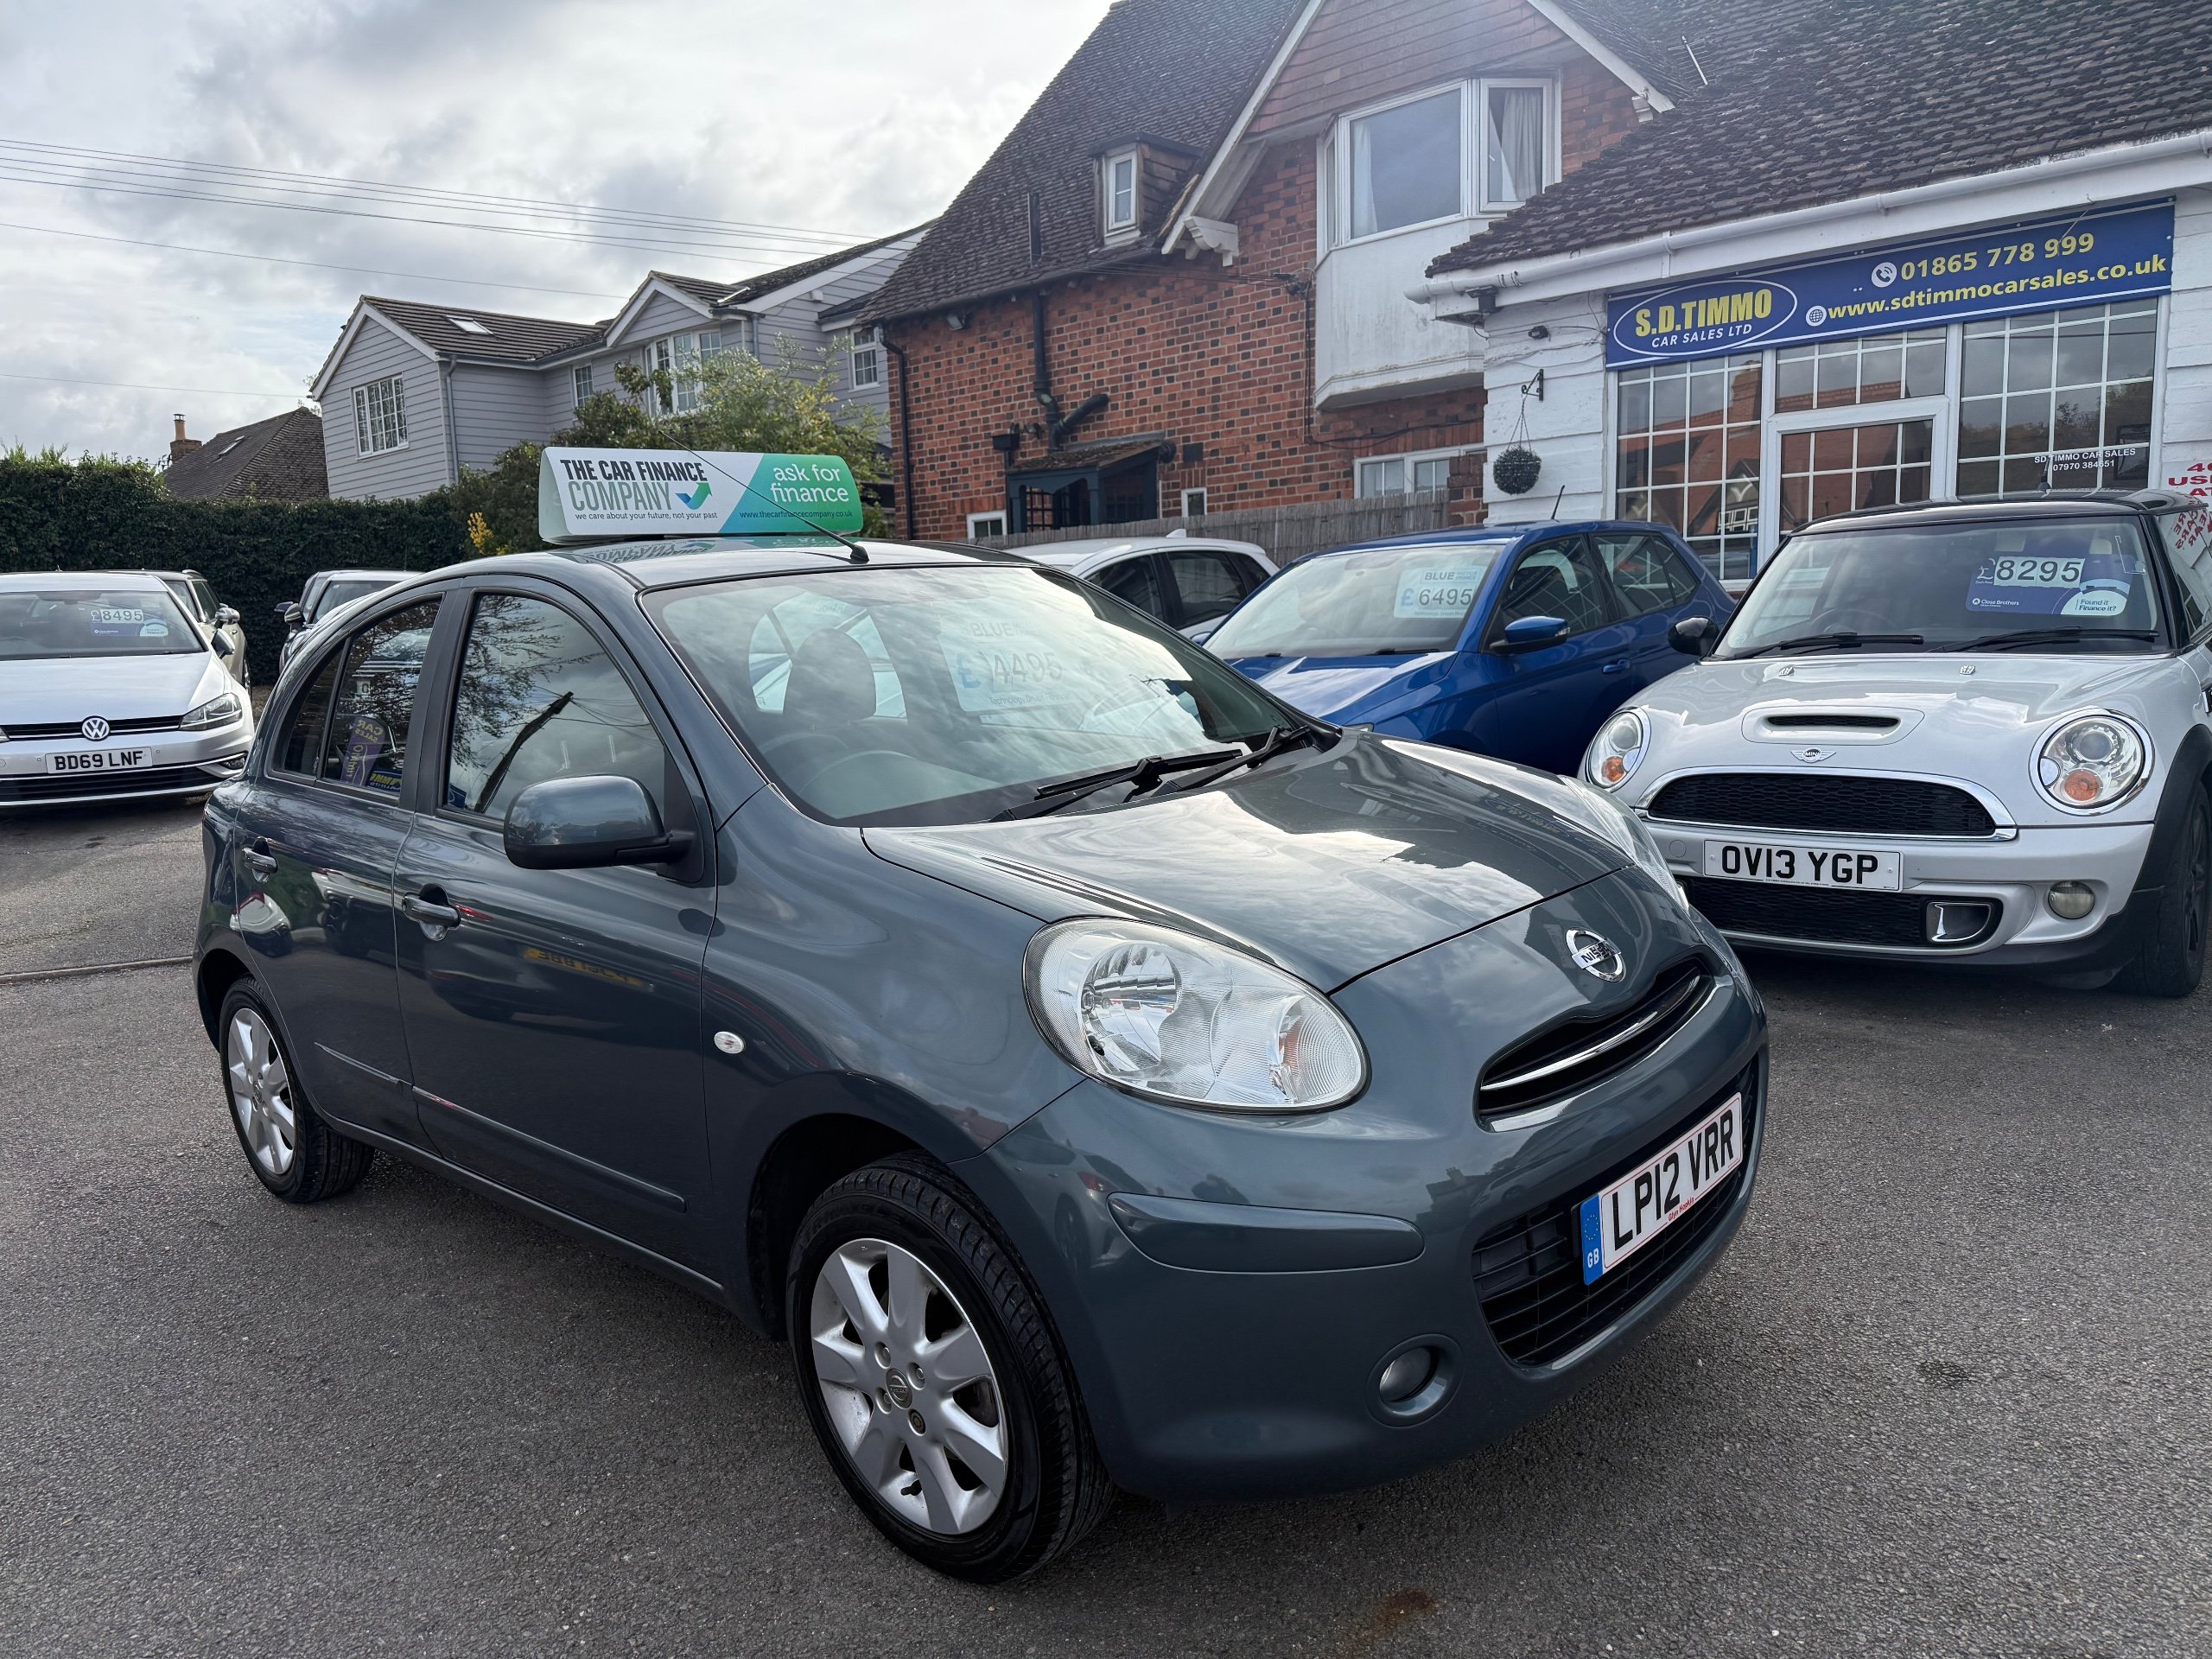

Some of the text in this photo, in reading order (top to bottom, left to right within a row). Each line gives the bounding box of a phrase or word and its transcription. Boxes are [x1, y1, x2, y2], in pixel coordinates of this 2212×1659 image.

[1900, 232, 2094, 281] 01865 778 999
[1827, 253, 2167, 320] www.sdtimmocarsales.co.uk
[1635, 289, 1772, 337] S.D.TIMMO
[1651, 323, 1752, 348] CAR SALES LTD
[2048, 453, 2080, 462] TIMMO
[2104, 448, 2136, 458] SALES
[560, 460, 709, 482] THE CAR FINANCE
[773, 464, 841, 481] ask for
[2053, 460, 2115, 471] 07970 384651
[2187, 463, 2212, 473] 4
[2169, 475, 2212, 486] US
[568, 481, 672, 512] COMPANY
[770, 483, 849, 503] finance
[740, 510, 853, 519] www.thecarfinancecompany.co.uk
[1424, 571, 1456, 581] BLUE
[971, 622, 1014, 638] BLUE
[54, 751, 143, 771] BD69 LNF
[1721, 845, 1878, 885] OV13 YGP
[1611, 1109, 1734, 1252] LP12 VRR
[1586, 1248, 1599, 1268] GB
